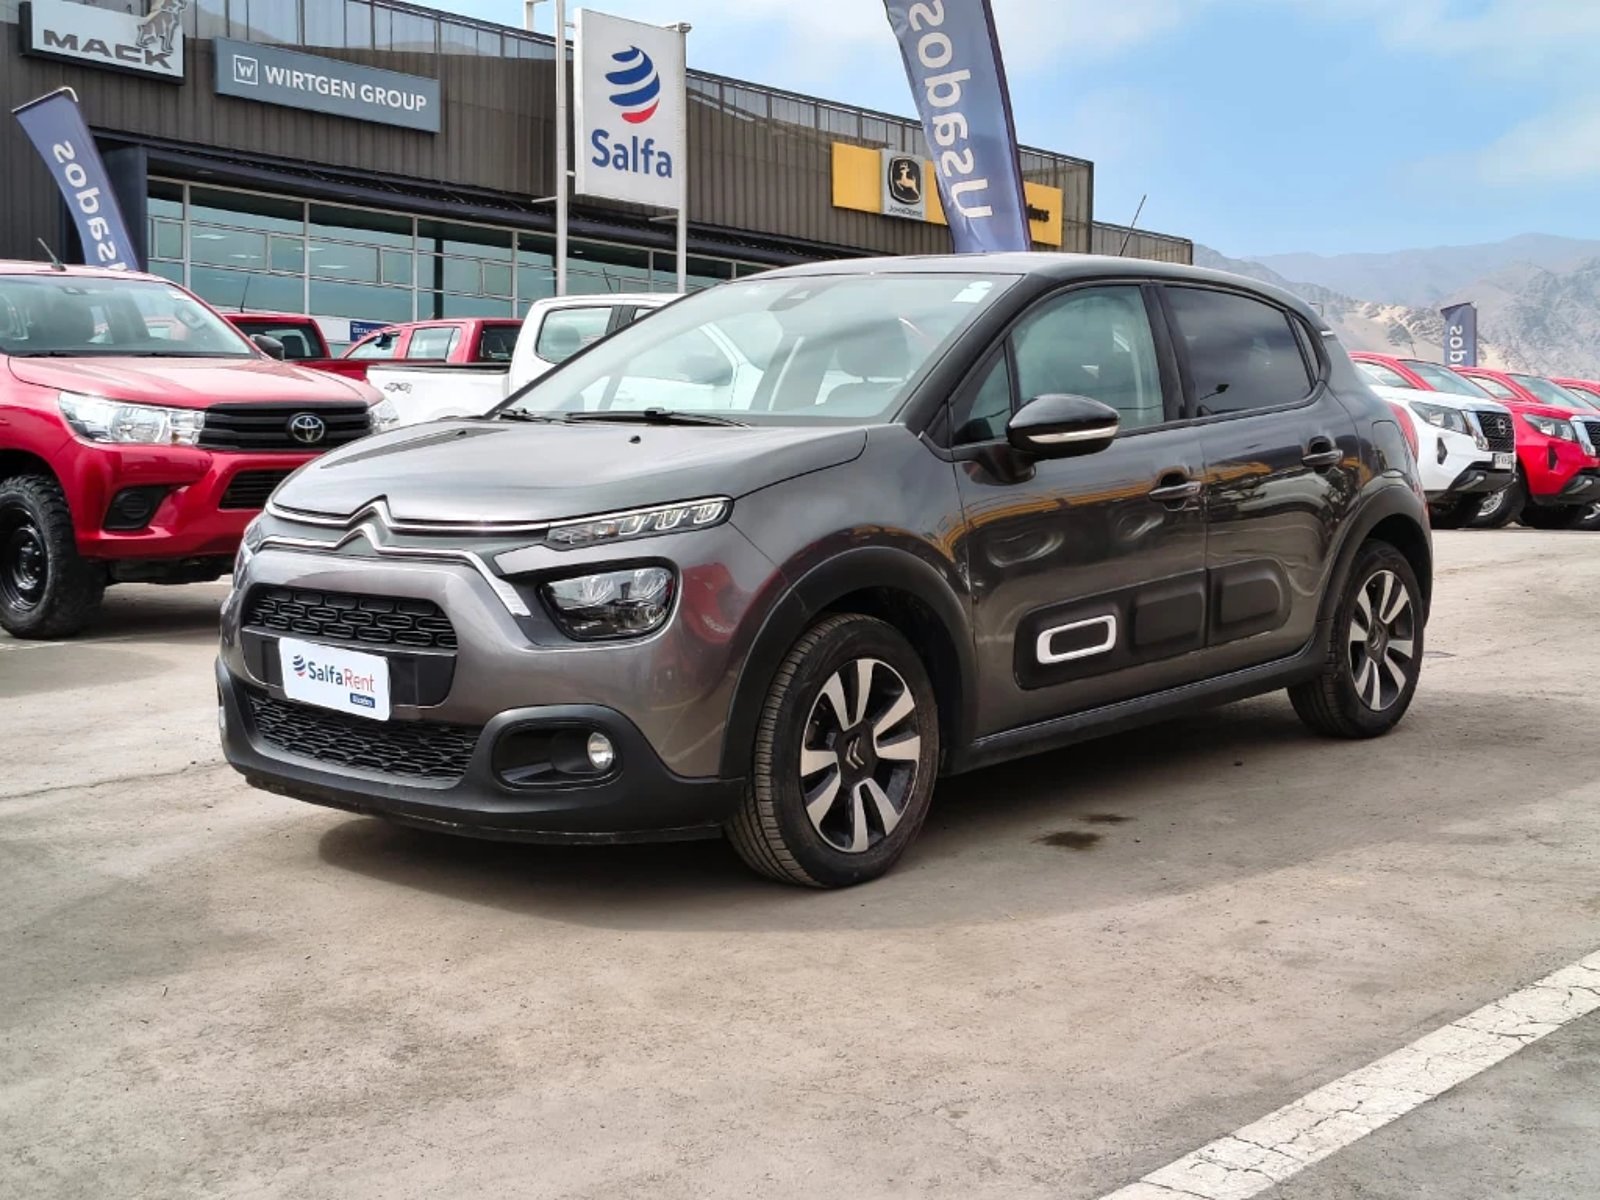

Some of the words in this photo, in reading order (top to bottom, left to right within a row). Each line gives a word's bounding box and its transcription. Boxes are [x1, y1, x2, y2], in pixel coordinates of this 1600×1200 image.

[43, 29, 172, 69] MACK
[265, 65, 356, 99] WIRTGEN
[360, 84, 427, 111] GROUP
[591, 128, 672, 178] Salfa
